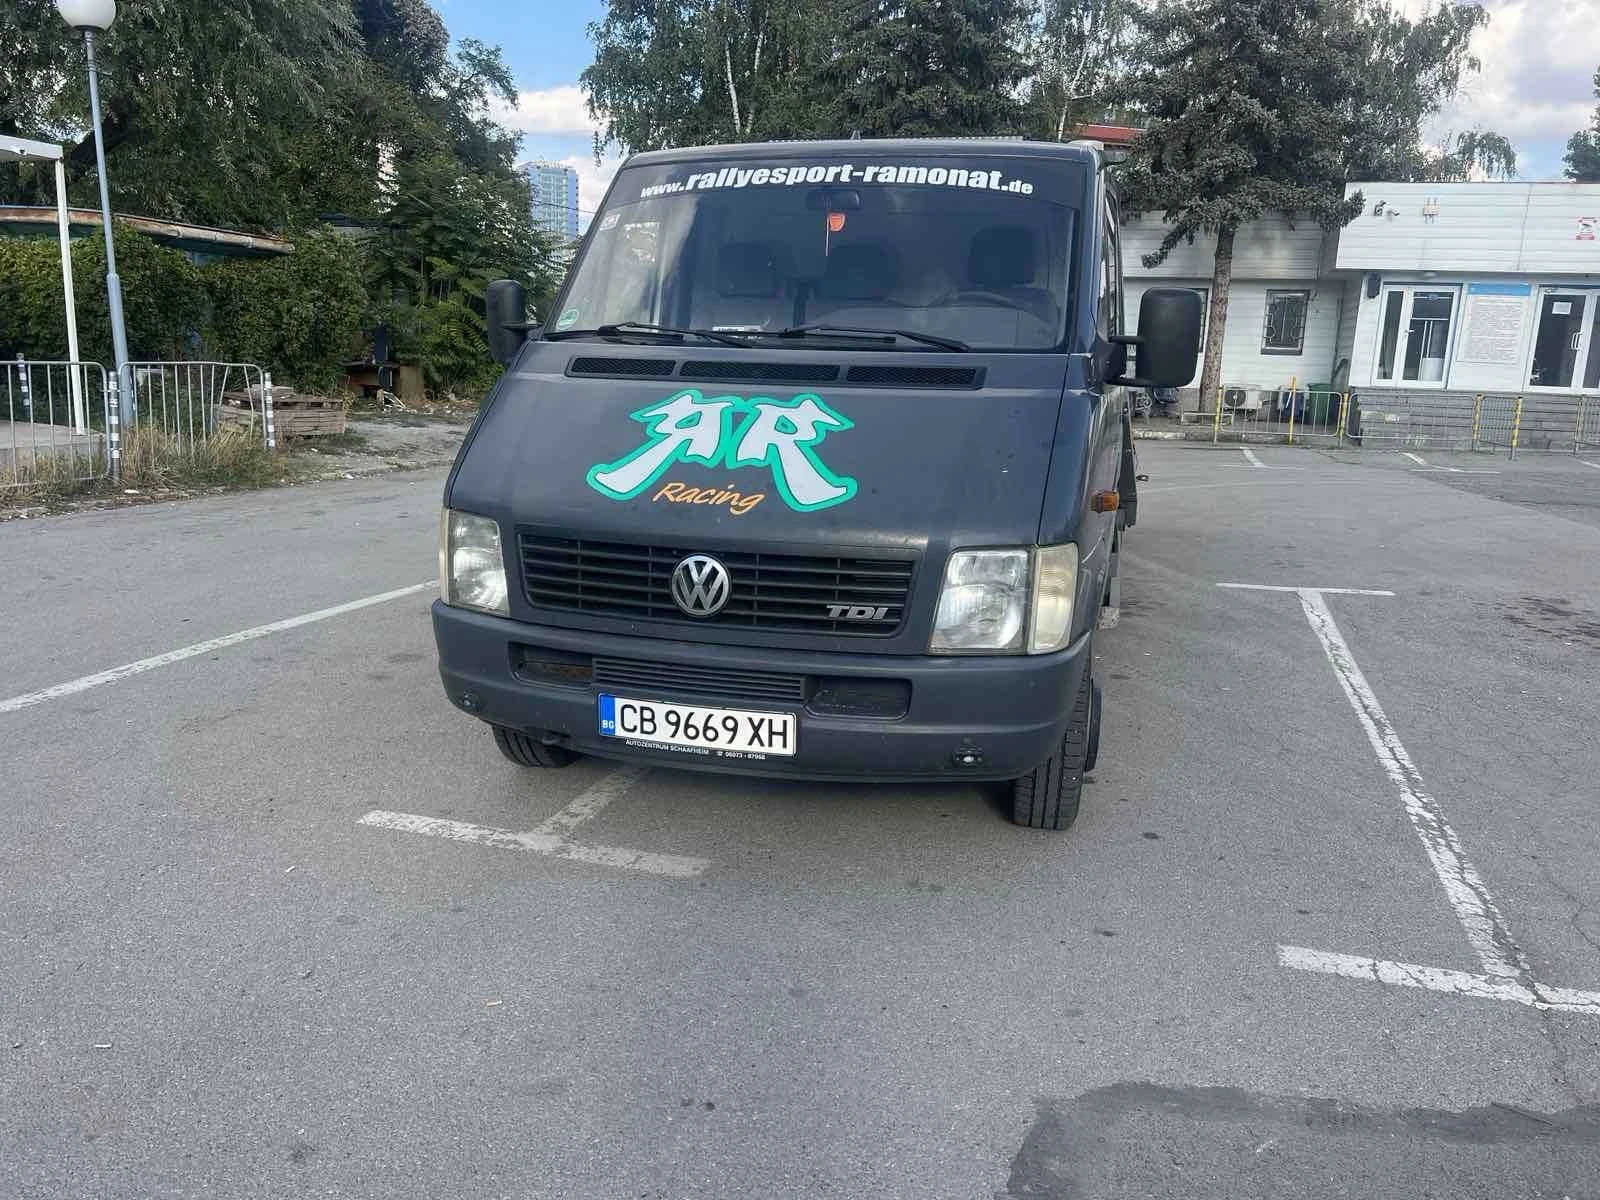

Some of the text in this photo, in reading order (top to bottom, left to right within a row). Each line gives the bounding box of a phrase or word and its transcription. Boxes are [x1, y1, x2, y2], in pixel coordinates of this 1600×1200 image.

[640, 164, 1034, 198] www.rallyesport-ramonat.de
[653, 482, 764, 514] Racing
[826, 604, 888, 620] TDI
[602, 719, 615, 729] BG
[620, 704, 787, 749] CB 9669 XH
[625, 739, 669, 751] AUTOZENTRUM
